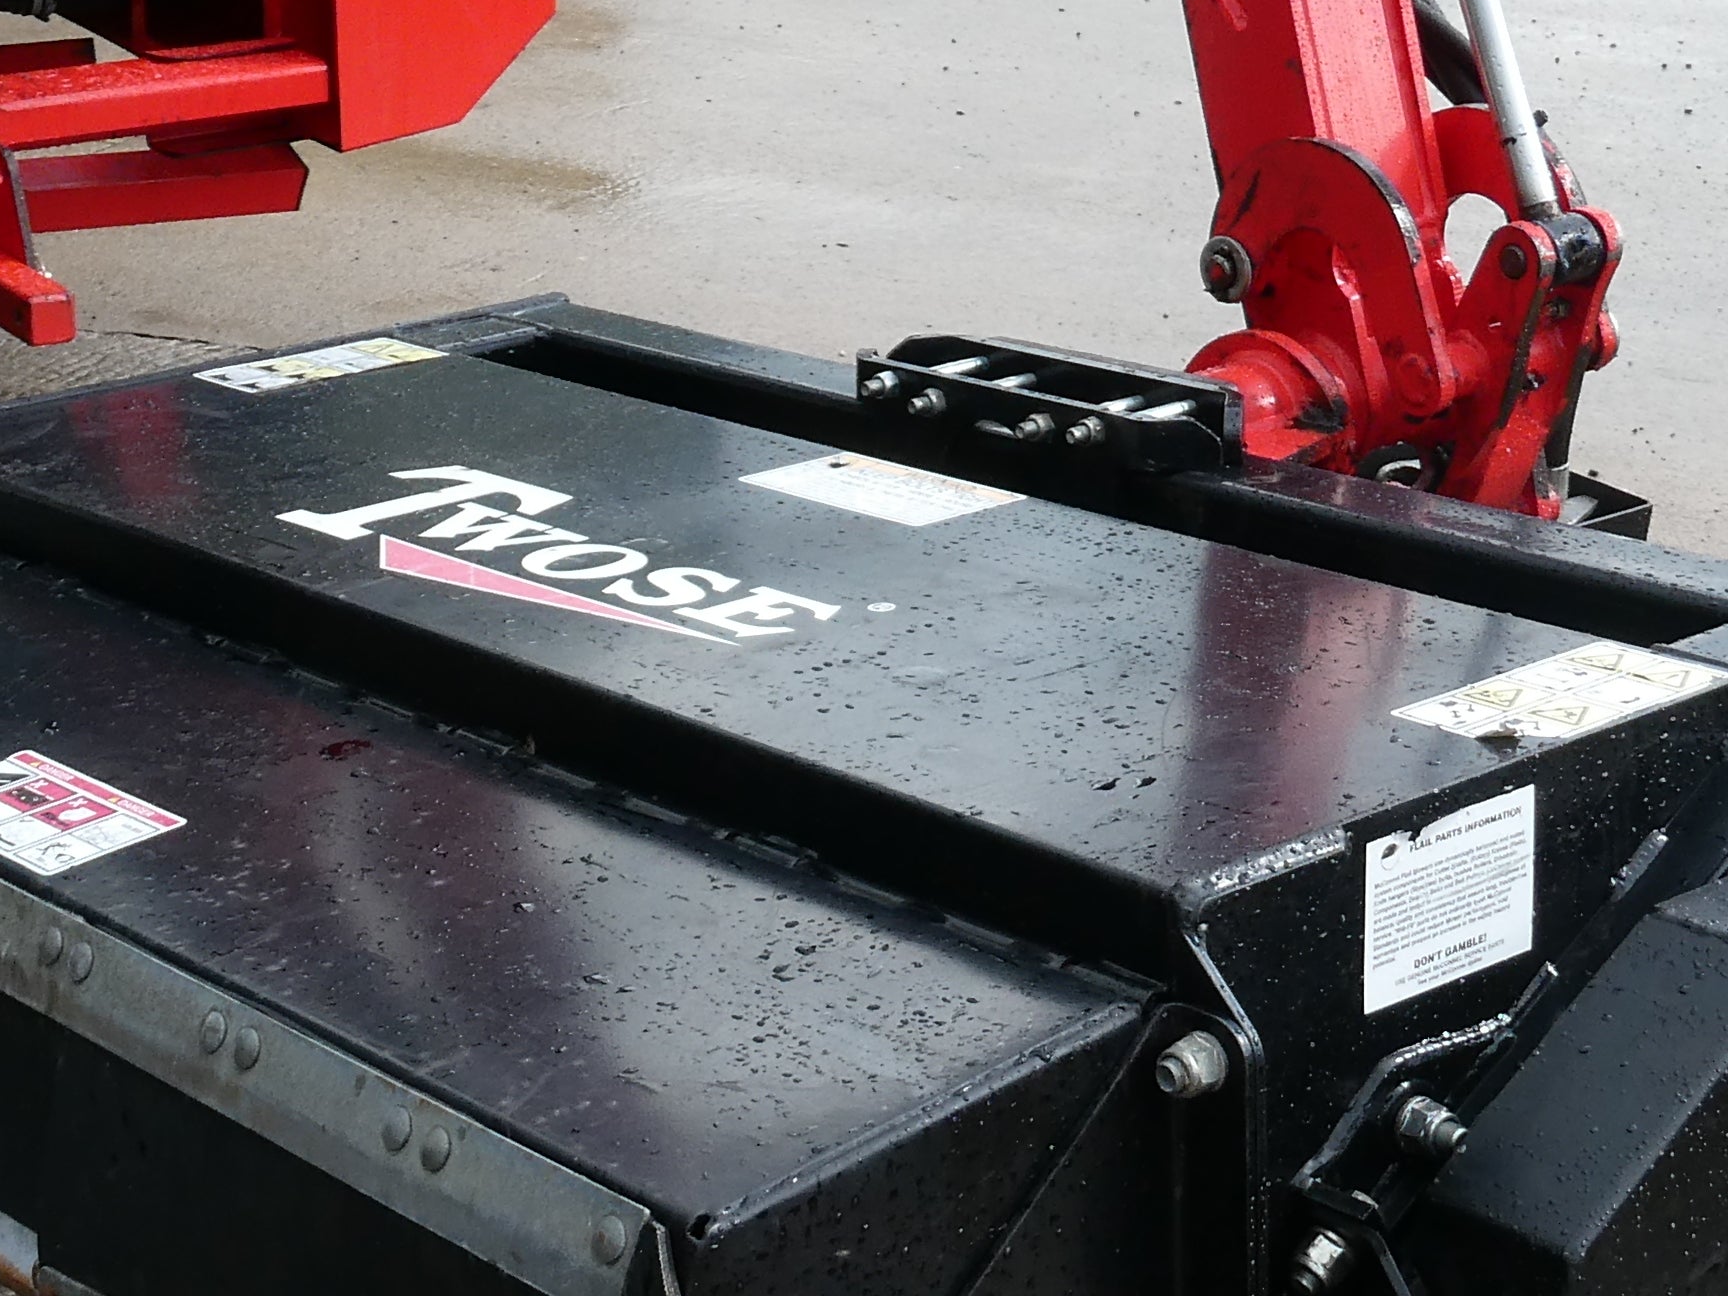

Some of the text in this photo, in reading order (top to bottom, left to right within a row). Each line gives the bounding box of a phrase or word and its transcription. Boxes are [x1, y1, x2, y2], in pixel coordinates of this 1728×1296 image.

[1435, 827, 1463, 843] PARTS
[1464, 806, 1522, 833] INFORMATION
[1413, 933, 1488, 969] DON'T GAMBLE!
